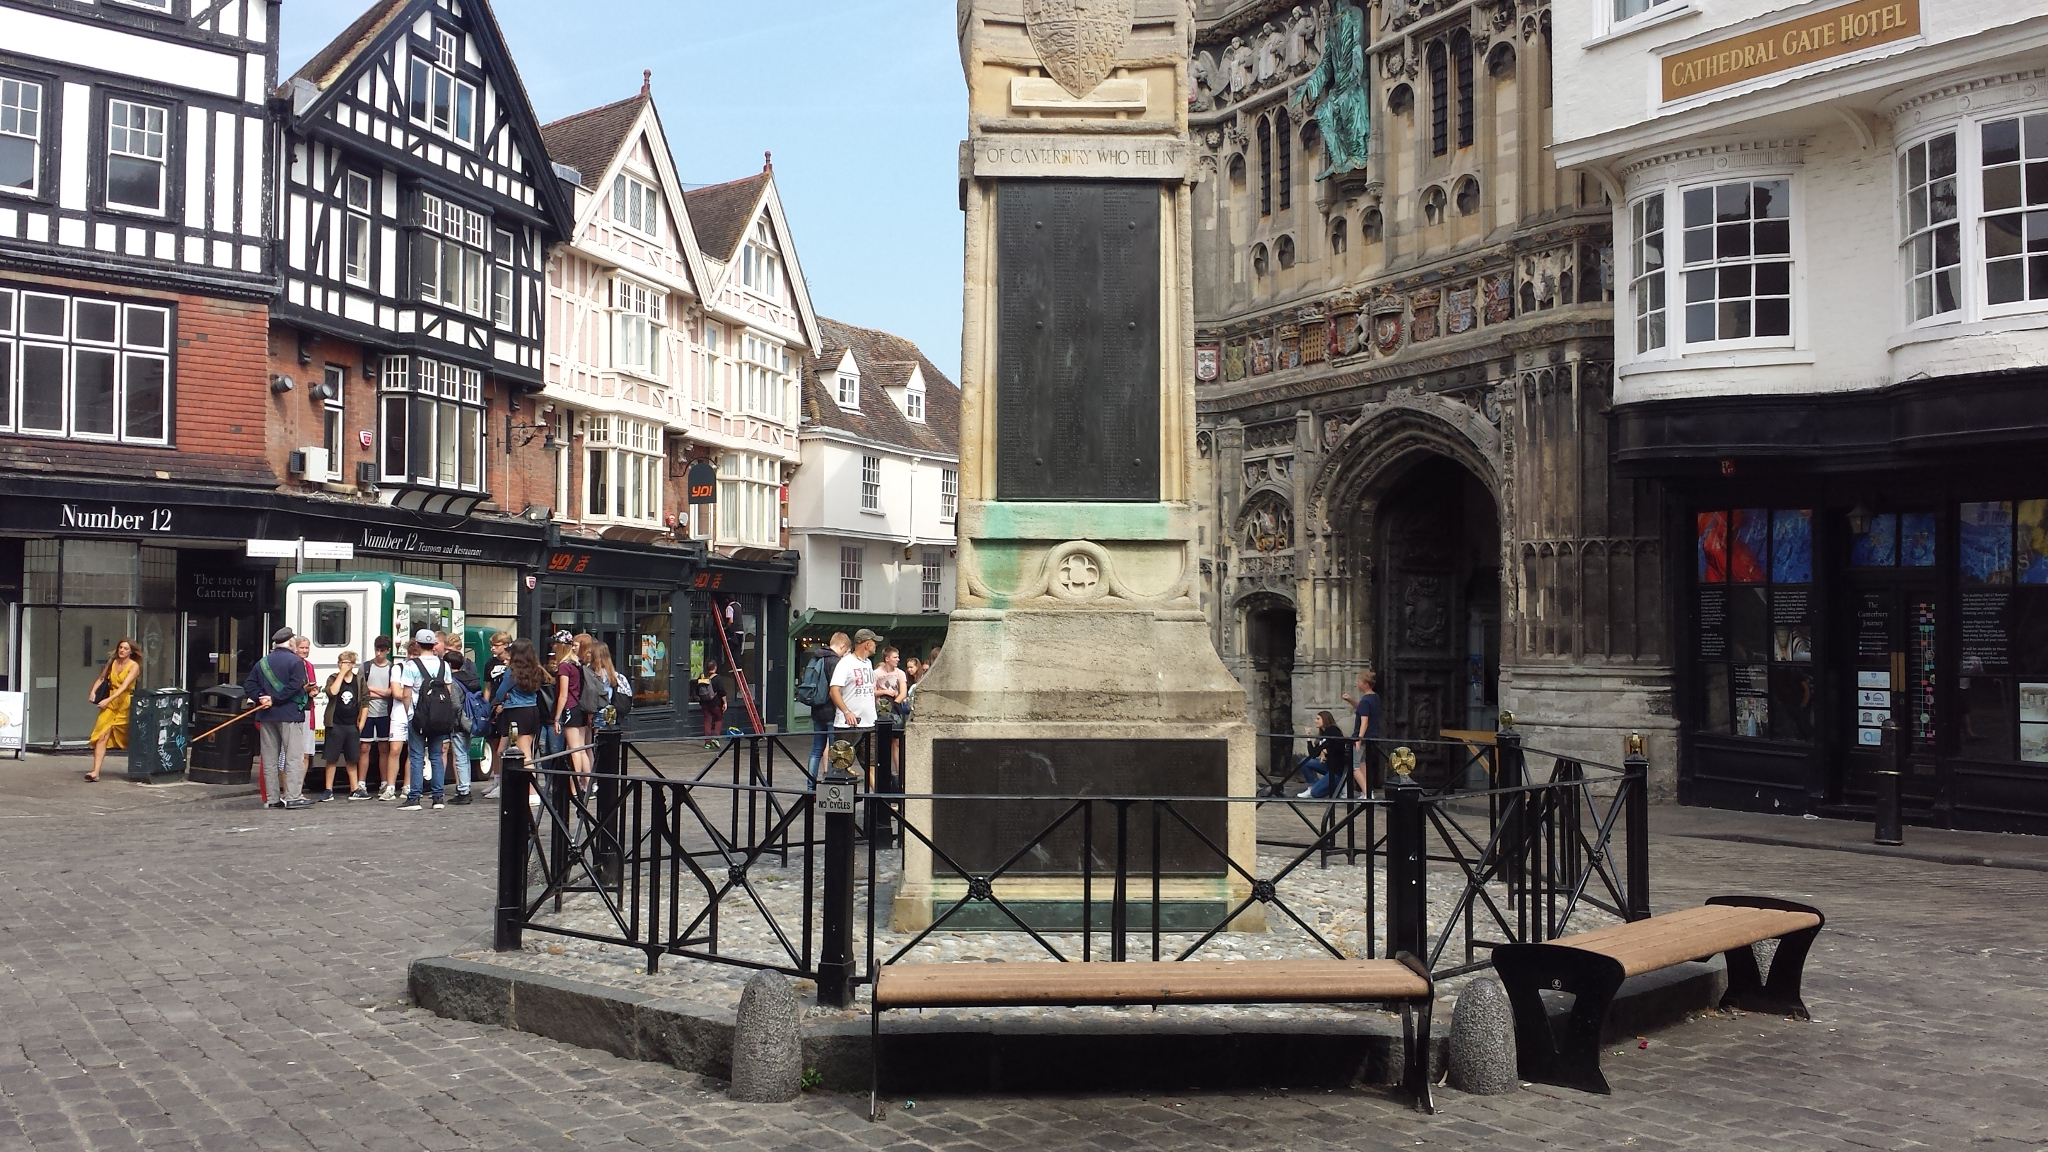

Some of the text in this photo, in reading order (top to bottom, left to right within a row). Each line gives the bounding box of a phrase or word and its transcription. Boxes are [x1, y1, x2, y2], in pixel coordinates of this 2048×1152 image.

[1671, 4, 1907, 87] CATHEDRAL GATE HOTEL
[987, 149, 1175, 165] OF CANTERBURY WHO FELL IN
[692, 486, 713, 497] YO!
[60, 504, 172, 531] Number 12
[359, 528, 403, 549] Number
[404, 532, 418, 551] 12
[418, 542, 441, 553] Tearoom
[443, 545, 453, 554] and
[454, 545, 482, 556] Restaurant
[548, 553, 574, 571] YO!
[194, 573, 256, 586] The taste of
[197, 586, 254, 601] Canterbury
[1858, 610, 1888, 618] Canterbury
[1862, 620, 1883, 628] Journey
[830, 801, 850, 810] CYCLES
